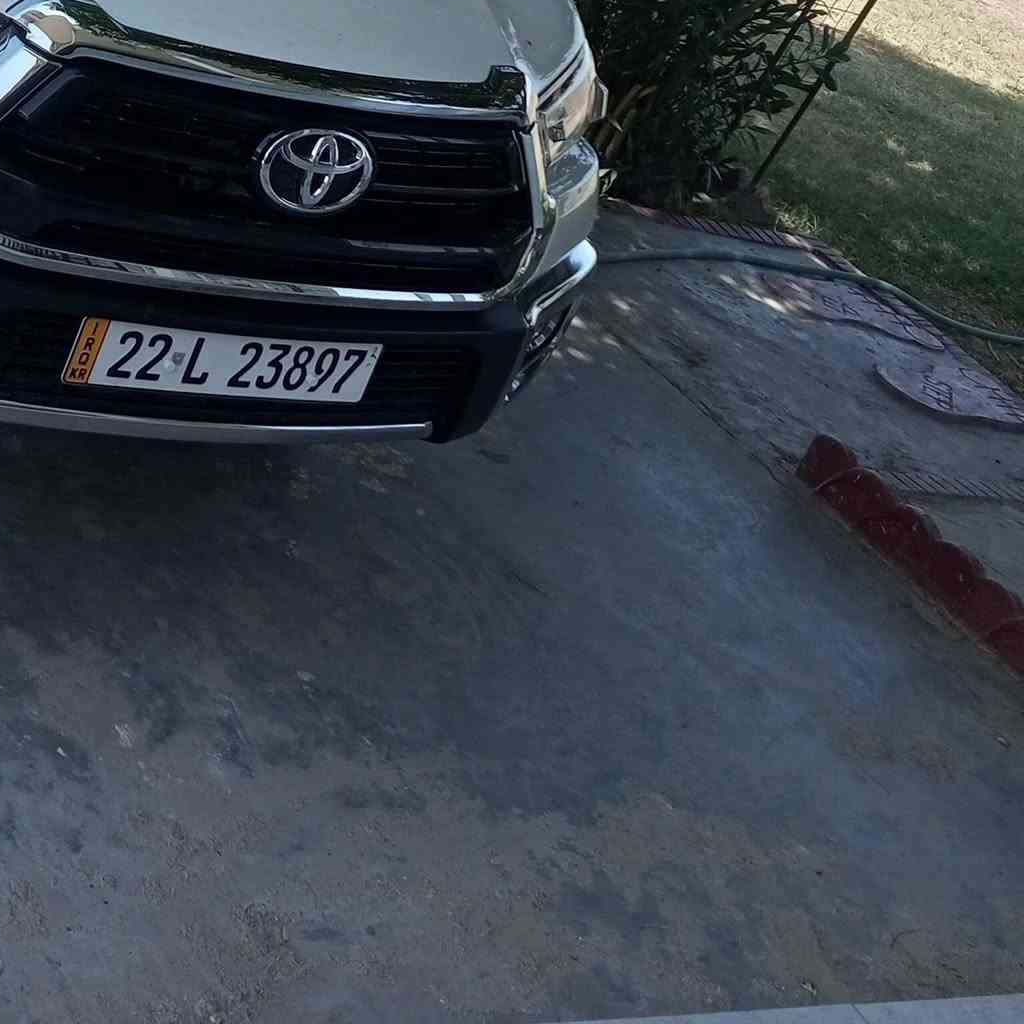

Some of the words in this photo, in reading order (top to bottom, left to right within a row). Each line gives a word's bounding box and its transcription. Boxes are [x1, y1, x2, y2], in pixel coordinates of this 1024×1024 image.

[106, 330, 173, 382] 22
[181, 337, 209, 385] L
[226, 342, 368, 394] 23897
